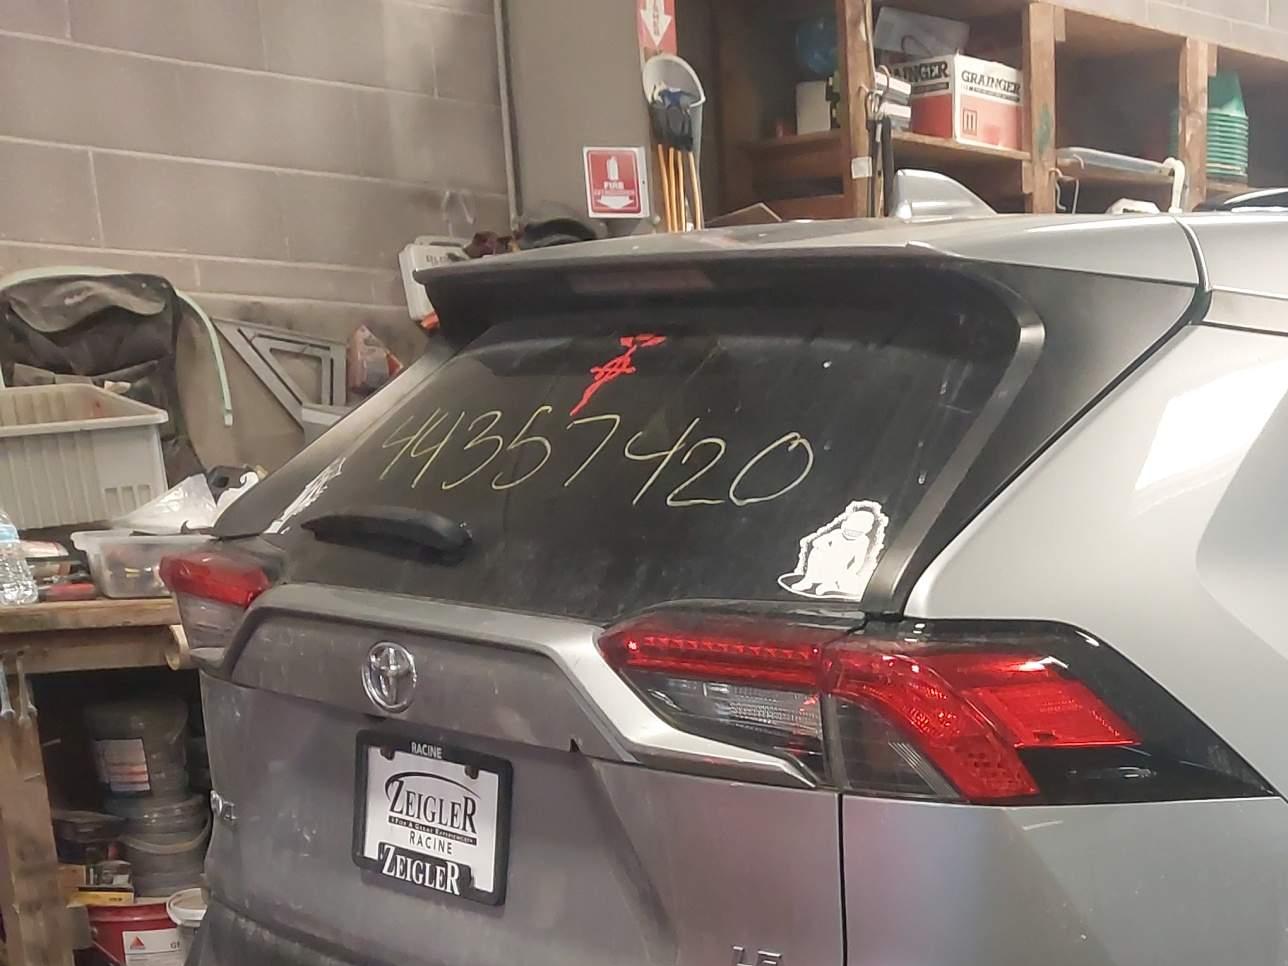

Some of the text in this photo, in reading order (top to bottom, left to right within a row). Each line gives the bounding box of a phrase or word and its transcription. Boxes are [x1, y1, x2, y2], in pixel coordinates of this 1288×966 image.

[961, 70, 1021, 95] GRAINGER
[379, 405, 814, 506] 44357420
[411, 741, 442, 759] RACINE
[389, 779, 477, 834] ZEIGLER
[409, 830, 453, 855] RACINE
[382, 845, 460, 895] ZEIGLER
